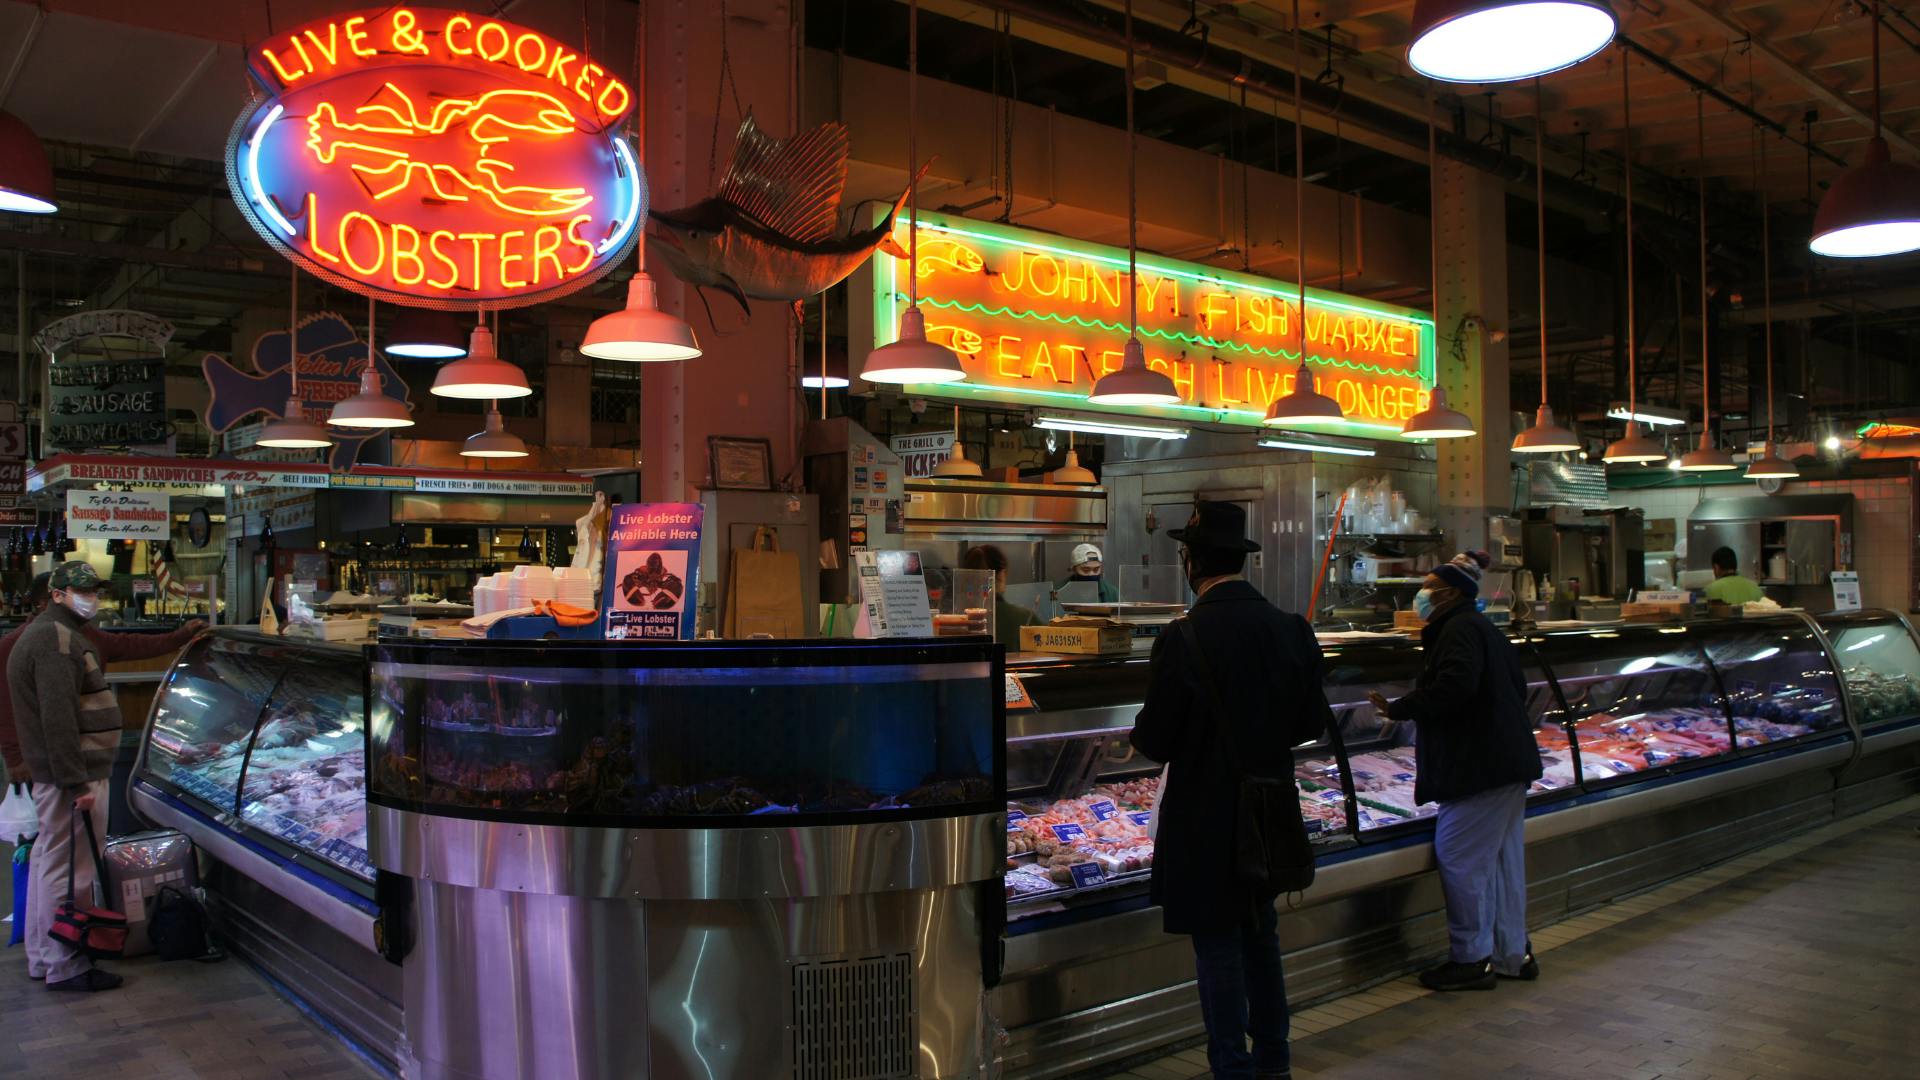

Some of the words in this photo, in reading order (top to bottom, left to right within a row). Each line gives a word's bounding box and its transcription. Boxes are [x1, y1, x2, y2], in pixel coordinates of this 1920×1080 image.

[263, 17, 377, 81] LIVE
[391, 9, 429, 55] &
[445, 16, 630, 117] COOKED
[308, 192, 596, 291] LOBSTERS
[1002, 252, 1121, 308] JOHN
[1137, 271, 1179, 317] YI
[1206, 292, 1289, 336] FISH
[1304, 310, 1423, 357] MARKET
[998, 335, 1086, 384] EAT
[1102, 350, 1194, 401] FH
[71, 390, 154, 414] SAUSAGE
[47, 420, 161, 443] SANDWICHES
[898, 439, 912, 450] THE
[913, 437, 934, 448] GRILL
[69, 463, 140, 481] BREAKFAST
[142, 467, 216, 483] SANDWICHES
[220, 470, 245, 481] All
[283, 474, 299, 483] BEEF
[420, 480, 446, 489] FRENCH
[448, 480, 467, 490] FRIES
[472, 481, 486, 490] HOT
[487, 482, 505, 490] DOGS
[72, 506, 110, 523] Sausage
[113, 506, 168, 522] Sandwiches
[619, 513, 644, 525] Live
[647, 512, 694, 525] Lobster
[610, 528, 667, 542] Available
[669, 529, 699, 541] Here
[626, 613, 643, 624] Live
[644, 613, 677, 624] Lobster
